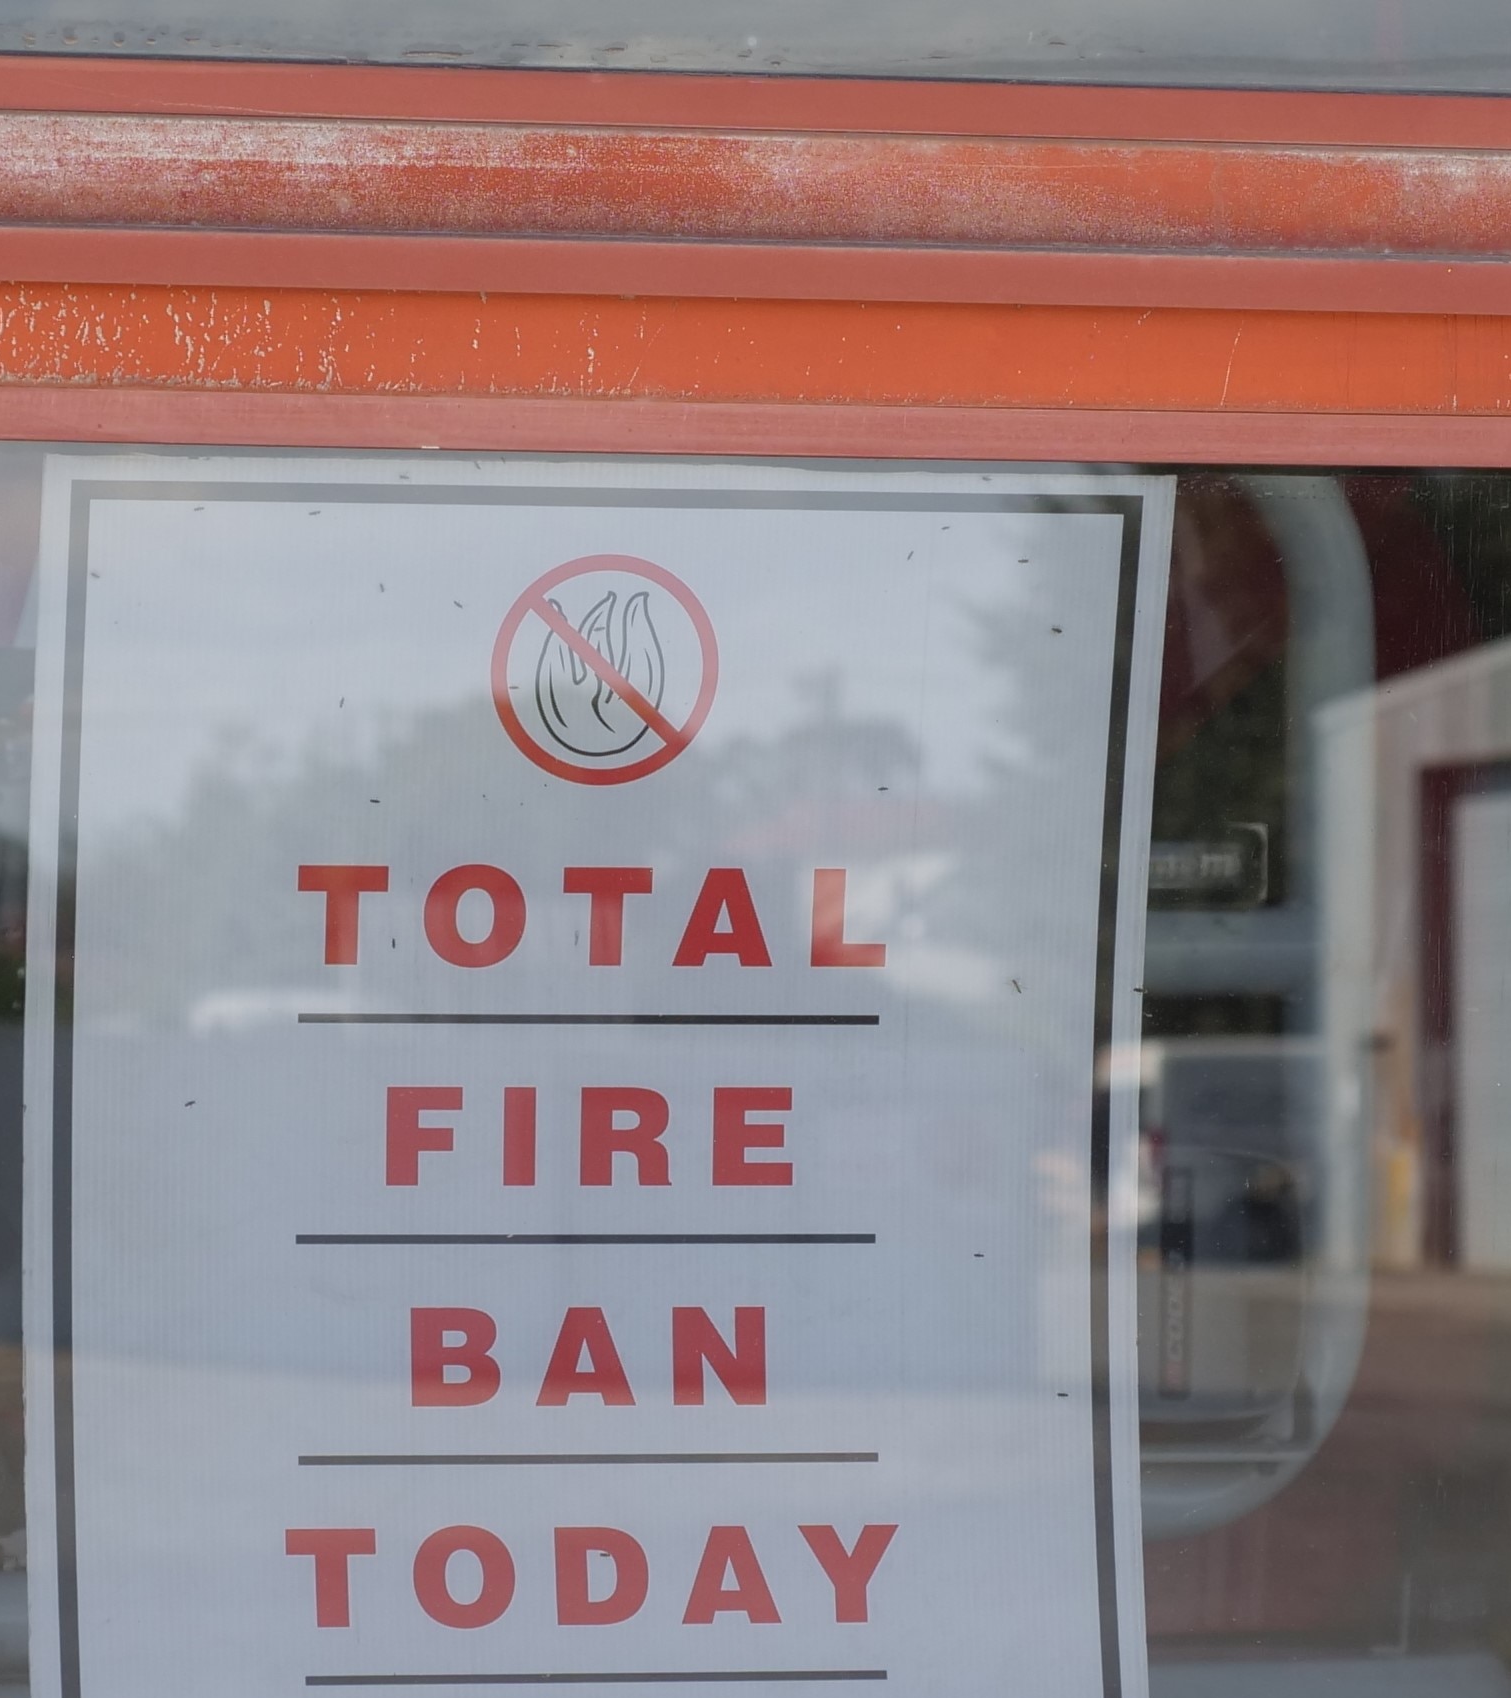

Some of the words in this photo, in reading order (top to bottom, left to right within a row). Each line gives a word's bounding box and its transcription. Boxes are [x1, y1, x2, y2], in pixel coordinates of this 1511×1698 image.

[297, 864, 886, 968] TOTAL
[386, 1086, 793, 1187] FIRE
[411, 1306, 766, 1407] BAN
[286, 1524, 898, 1628] TODAY
